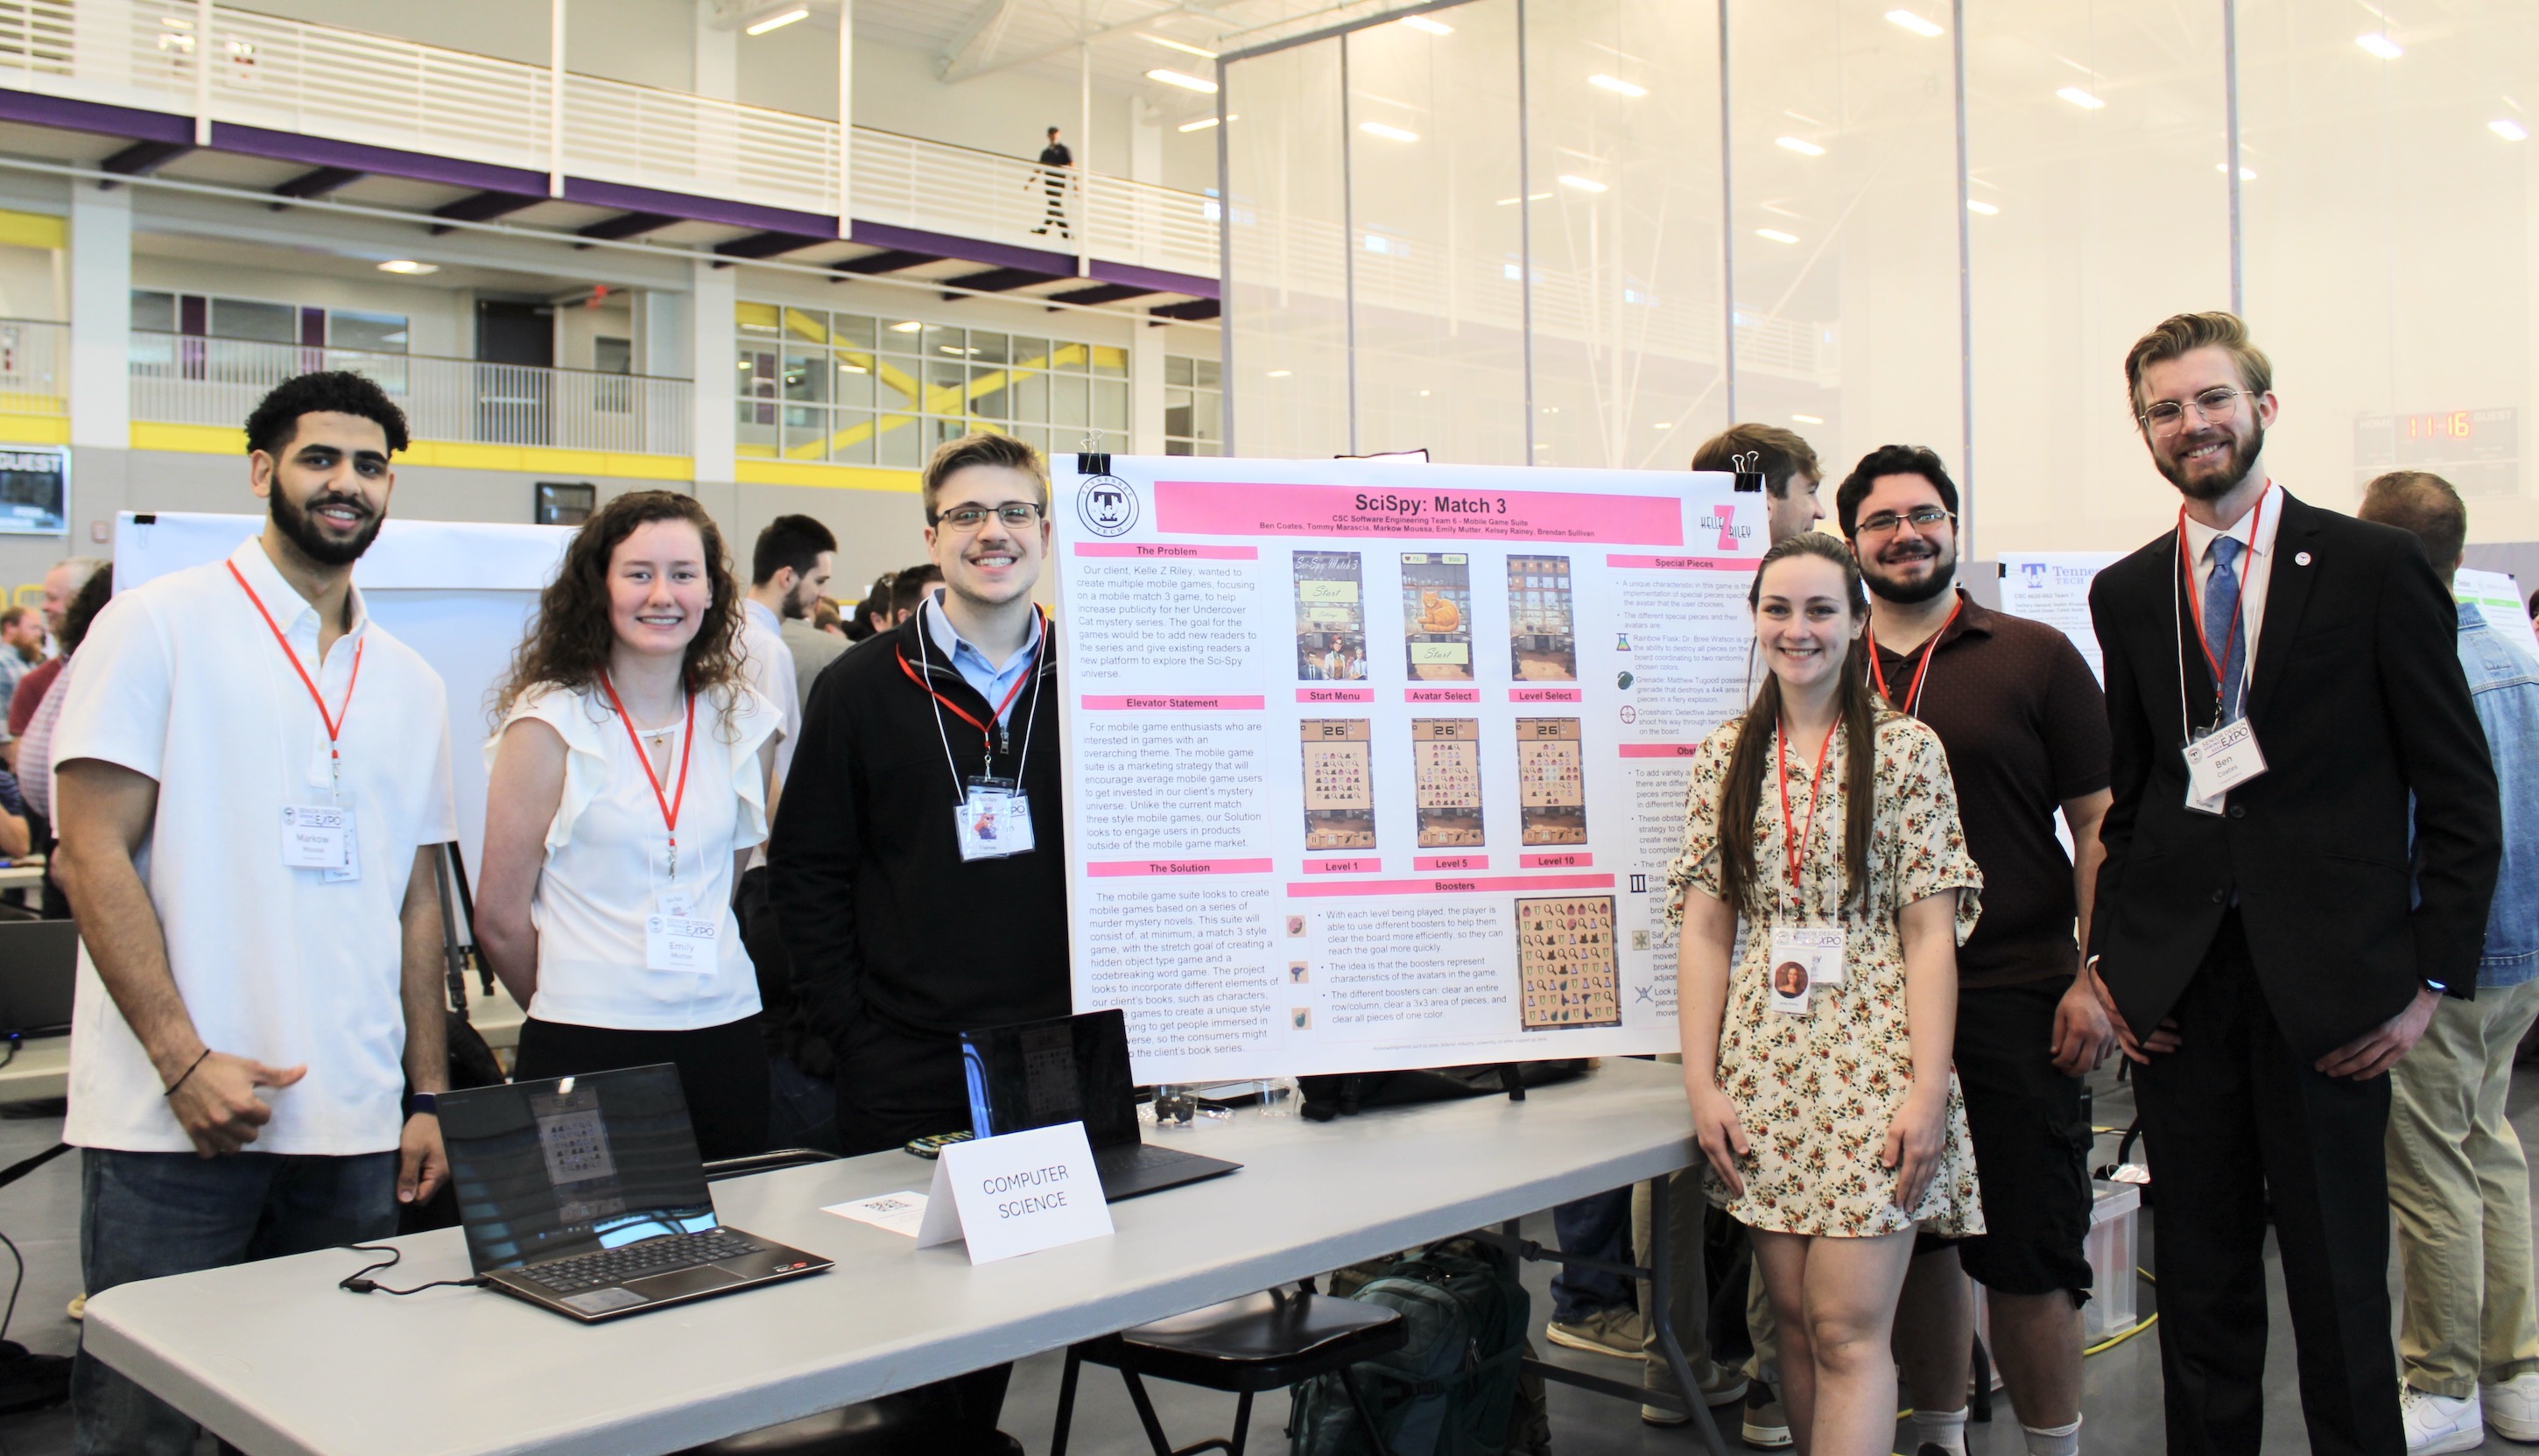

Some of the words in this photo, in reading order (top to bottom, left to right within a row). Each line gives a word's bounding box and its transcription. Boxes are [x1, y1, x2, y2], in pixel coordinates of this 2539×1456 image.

[0, 453, 62, 473] GUEST
[1082, 477, 1134, 497] TENNESSEE
[1355, 494, 1426, 515] SciSpy:
[1435, 496, 1489, 513] Match
[1496, 498, 1506, 514] 3
[1332, 515, 1348, 524] CSC
[1351, 515, 1383, 524] Software
[1385, 516, 1429, 525] Engineering
[1431, 517, 1450, 526] Team
[1306, 523, 1334, 531] Tommy
[1485, 526, 1508, 535] Kelsey
[1509, 527, 1535, 536] Rainey,
[1701, 517, 1723, 529] KELLE
[1729, 525, 1750, 538] RILEY
[1157, 546, 1197, 555] Problem
[1328, 558, 1350, 570] Match
[1352, 560, 1359, 570] 3
[1655, 559, 1684, 567] Special
[1103, 566, 1130, 575] client,
[1170, 566, 1194, 577] Riley,
[1108, 579, 1143, 589] multiple
[1147, 579, 1177, 587] mobile
[1180, 581, 1213, 590] games,
[1217, 580, 1255, 590] focusing
[1099, 591, 1129, 600] mobile
[1133, 592, 1161, 601] match
[1164, 592, 1170, 601] 3
[1173, 594, 1202, 602] game,
[1216, 593, 1235, 602] help
[1312, 586, 1341, 597] Start
[1424, 647, 1452, 658] Start
[1545, 691, 1572, 700] Select
[1090, 722, 1105, 731] For
[1108, 722, 1139, 731] mobile
[1142, 724, 1168, 733] game
[1171, 722, 1222, 731] enthusiasts
[1324, 726, 1345, 735] 26
[1434, 726, 1455, 735] 26
[1537, 726, 1558, 735] 26
[2202, 734, 2224, 747] SENIOR
[2224, 721, 2246, 735] DESIGN
[2220, 727, 2248, 747] EXPO
[2215, 756, 2233, 769] Ben
[2217, 764, 2238, 777] Coates
[315, 815, 341, 827] EXPO
[296, 834, 329, 844] Markow
[1436, 859, 1459, 868] Level
[1538, 856, 1561, 865] Level
[1170, 863, 1210, 872] Solution
[1096, 892, 1114, 901] The
[1117, 891, 1148, 900] mobile
[1150, 892, 1176, 901] game
[1178, 890, 1199, 899] suite
[1203, 890, 1227, 898] looks
[1241, 889, 1269, 897] create
[1370, 909, 1389, 918] level
[1391, 909, 1414, 918] being
[1417, 907, 1445, 918] played,
[1462, 906, 1486, 916] player
[686, 925, 714, 936] EXPO
[669, 941, 694, 953] Emily
[1446, 957, 1484, 967] represent
[983, 1165, 1068, 1194] COMPUTER
[998, 1191, 1067, 1218] SCIENCE
